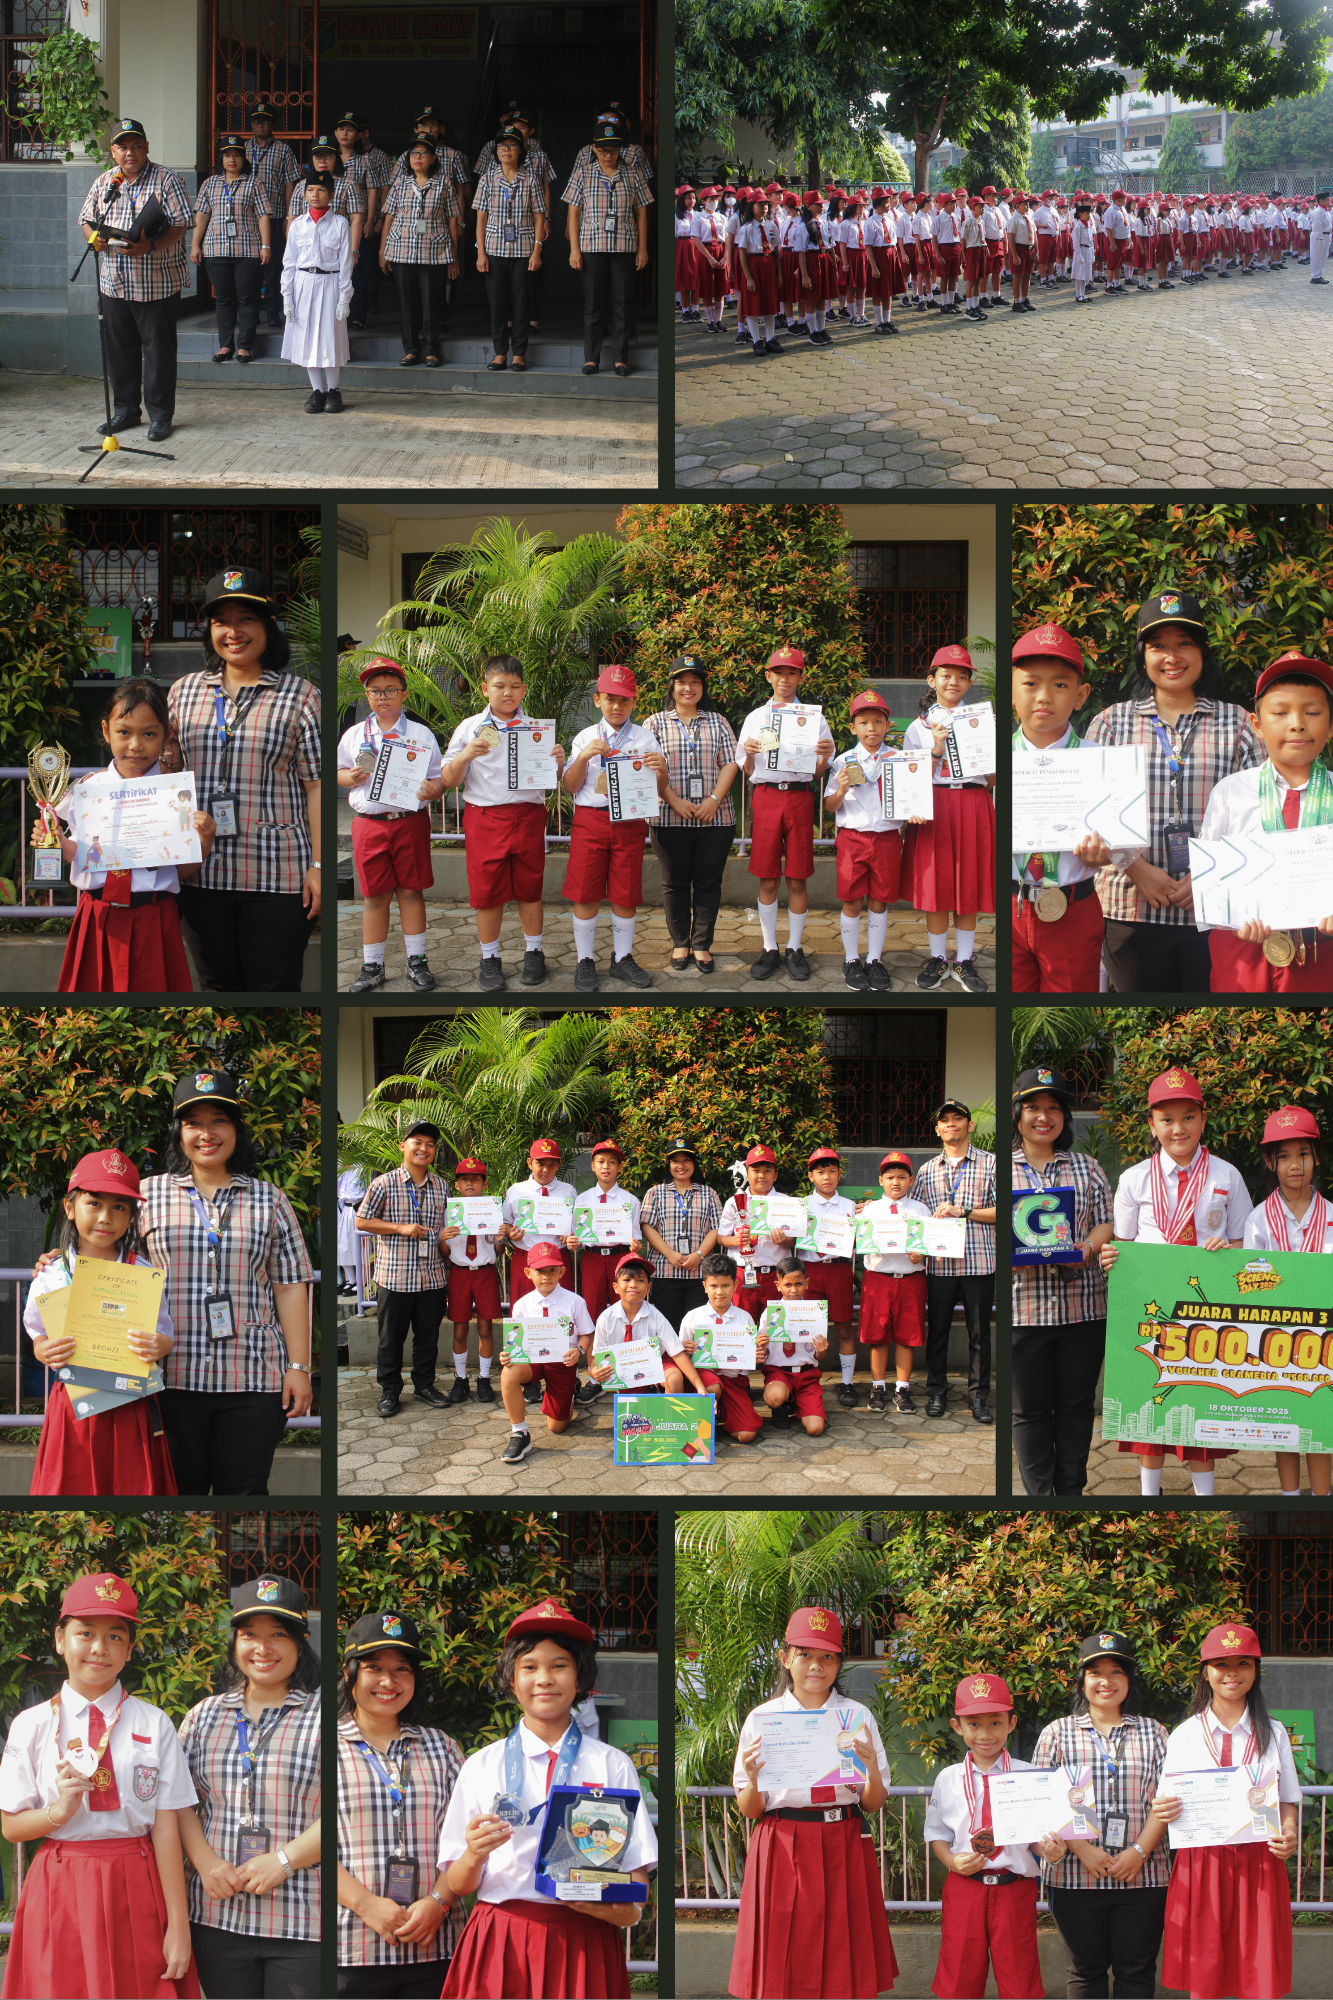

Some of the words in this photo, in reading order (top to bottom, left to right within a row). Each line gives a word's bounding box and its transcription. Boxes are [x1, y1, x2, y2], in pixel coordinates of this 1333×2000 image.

[338, 15, 409, 39] KANTIN
[413, 14, 475, 39] SEHAT
[341, 43, 363, 55] SD
[367, 43, 414, 55] Mardi
[420, 43, 472, 55] Yuana
[371, 745, 391, 800] CERTIFICATE
[609, 763, 620, 819] CERTIFICATE
[885, 764, 893, 818] CERTIFICATE
[98, 1274, 138, 1286] CERTIFICATE
[1237, 1271, 1283, 1286] SCIENCE
[92, 1286, 138, 1299] APPRECIATION
[1239, 1282, 1260, 1295] DAY
[1177, 1304, 1232, 1321] JUARA
[1238, 1307, 1314, 1324] HARAPAN
[1318, 1311, 1328, 1324] 3
[1139, 1321, 1161, 1338] RP
[92, 1343, 120, 1354] BRONZE
[1222, 1368, 1279, 1381] GRAMEDIA
[1220, 1405, 1265, 1414] OKTOBER
[1266, 1407, 1289, 1415] 2025
[656, 1422, 689, 1431] JUARA
[691, 1422, 699, 1431] 2
[632, 1752, 658, 1769] 50
